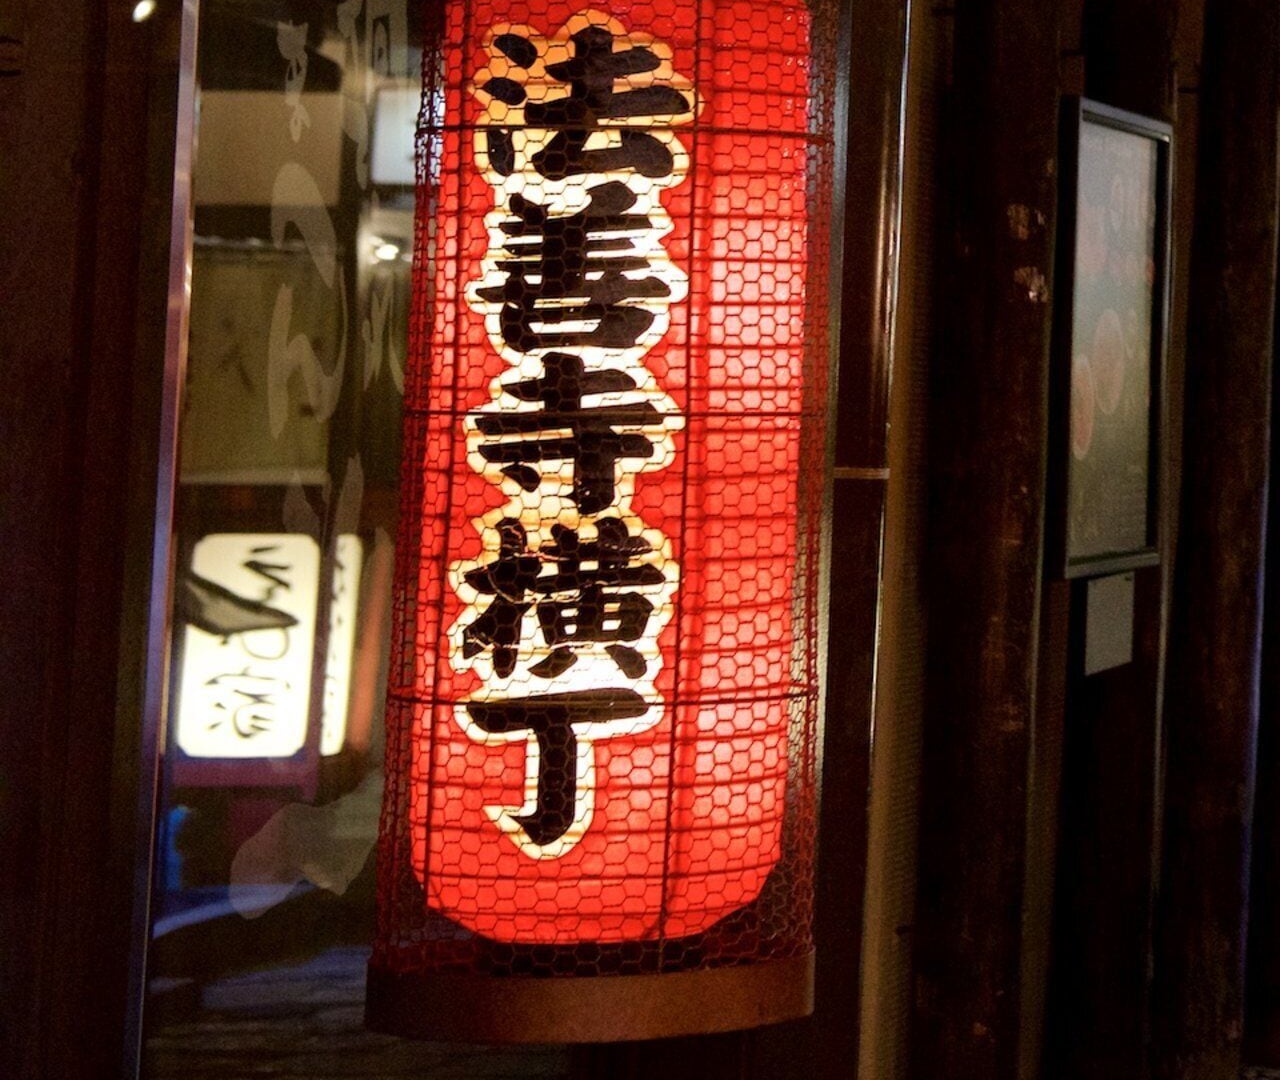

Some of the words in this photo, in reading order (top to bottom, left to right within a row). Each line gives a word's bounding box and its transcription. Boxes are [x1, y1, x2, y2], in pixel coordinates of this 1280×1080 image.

[465, 25, 695, 848] 法善寺横丁
